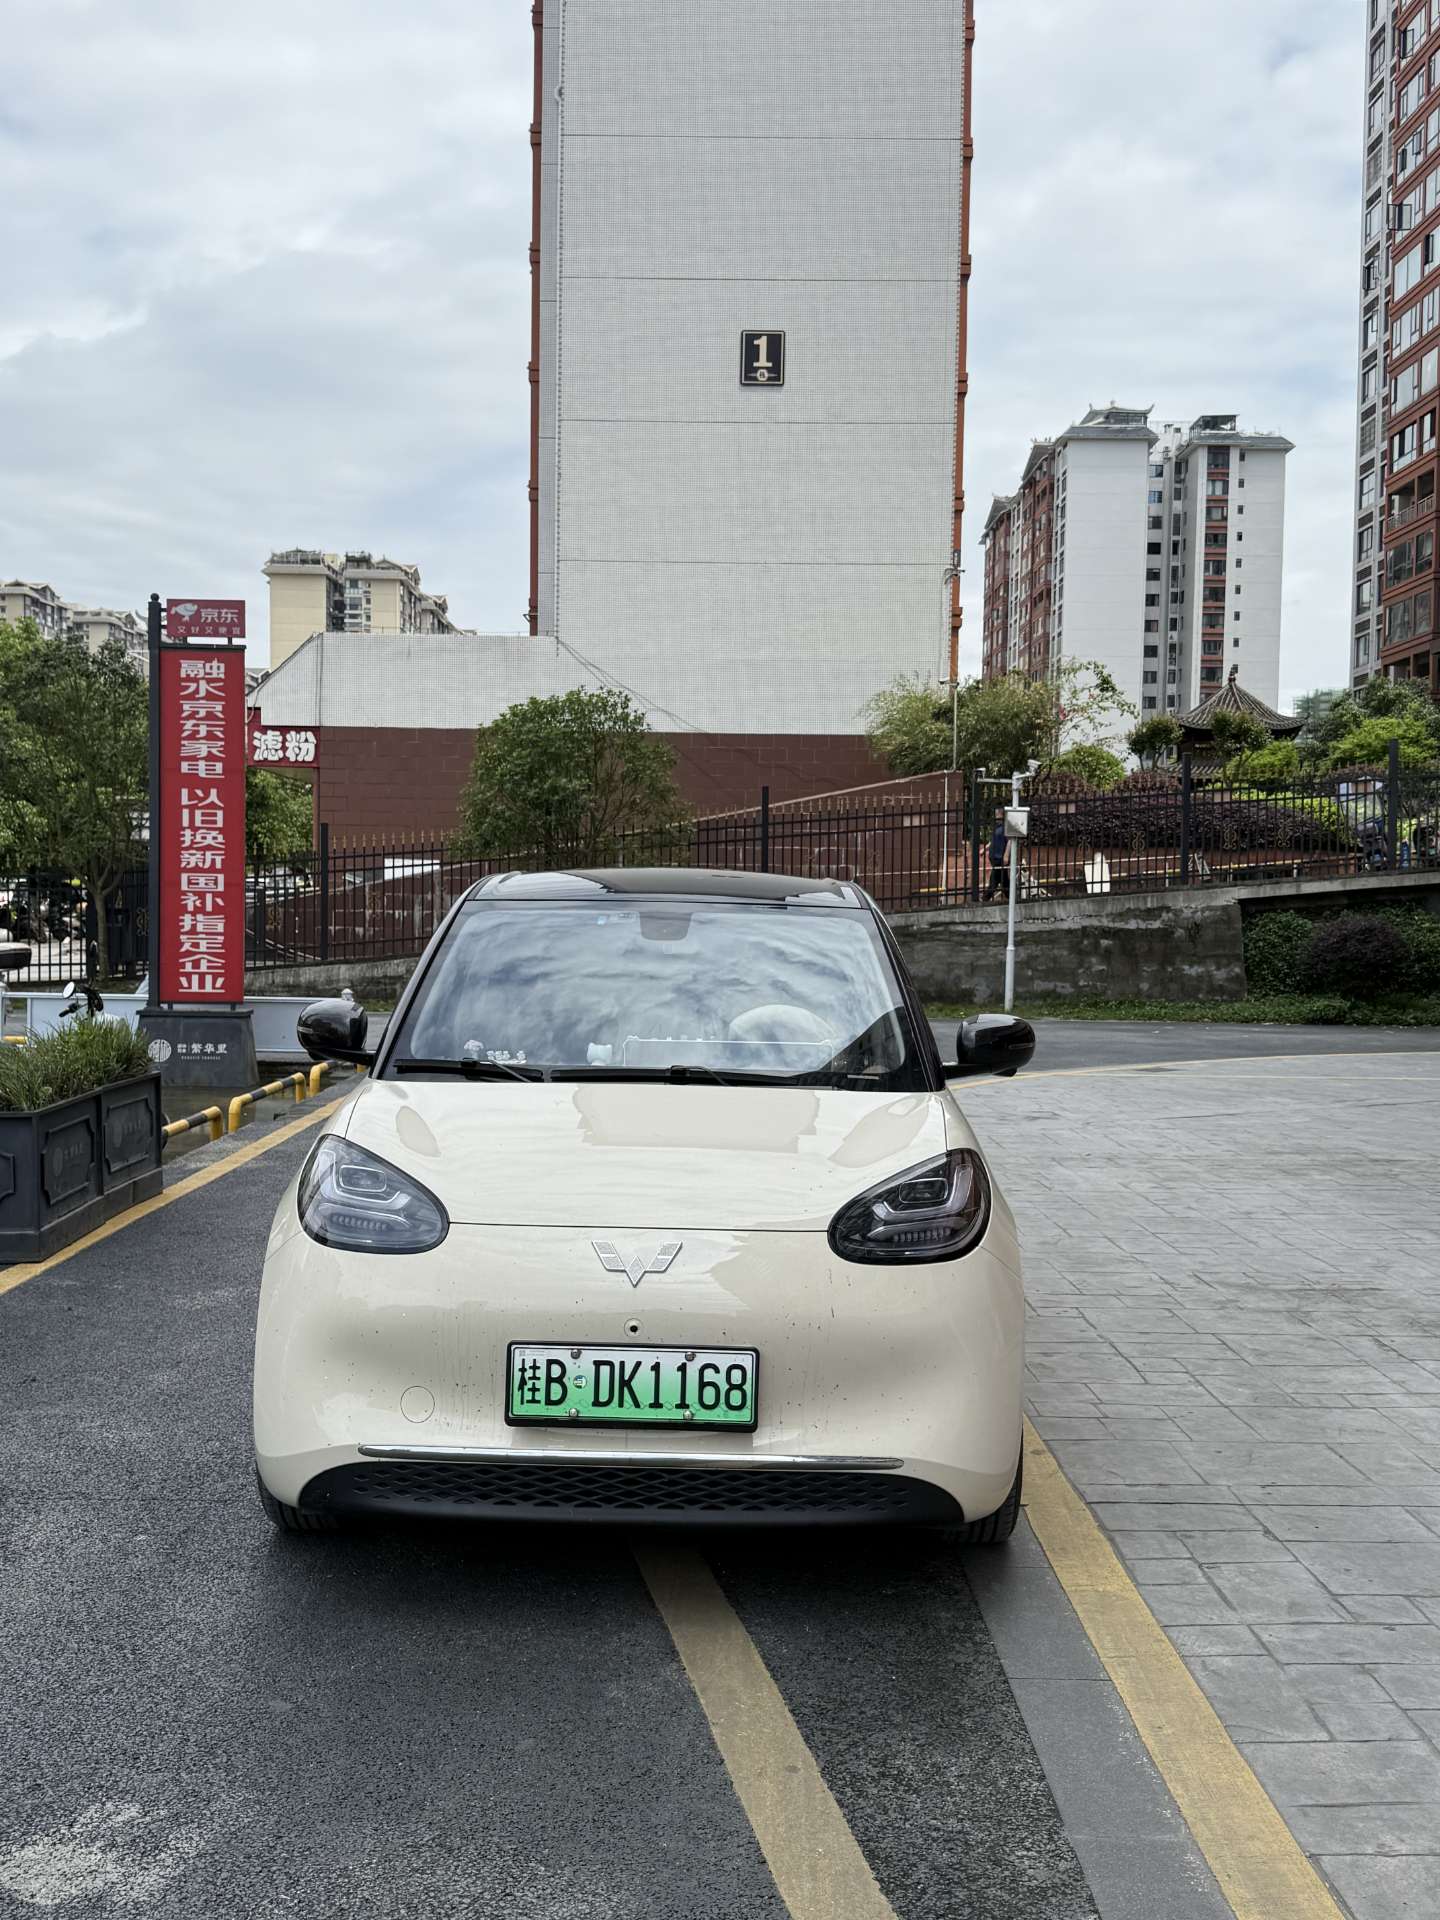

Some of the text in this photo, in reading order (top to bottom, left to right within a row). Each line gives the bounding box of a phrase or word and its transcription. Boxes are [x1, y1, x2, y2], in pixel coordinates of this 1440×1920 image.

[753, 335, 773, 367] 1
[200, 607, 239, 623] 京东
[252, 730, 317, 762] 滤粉
